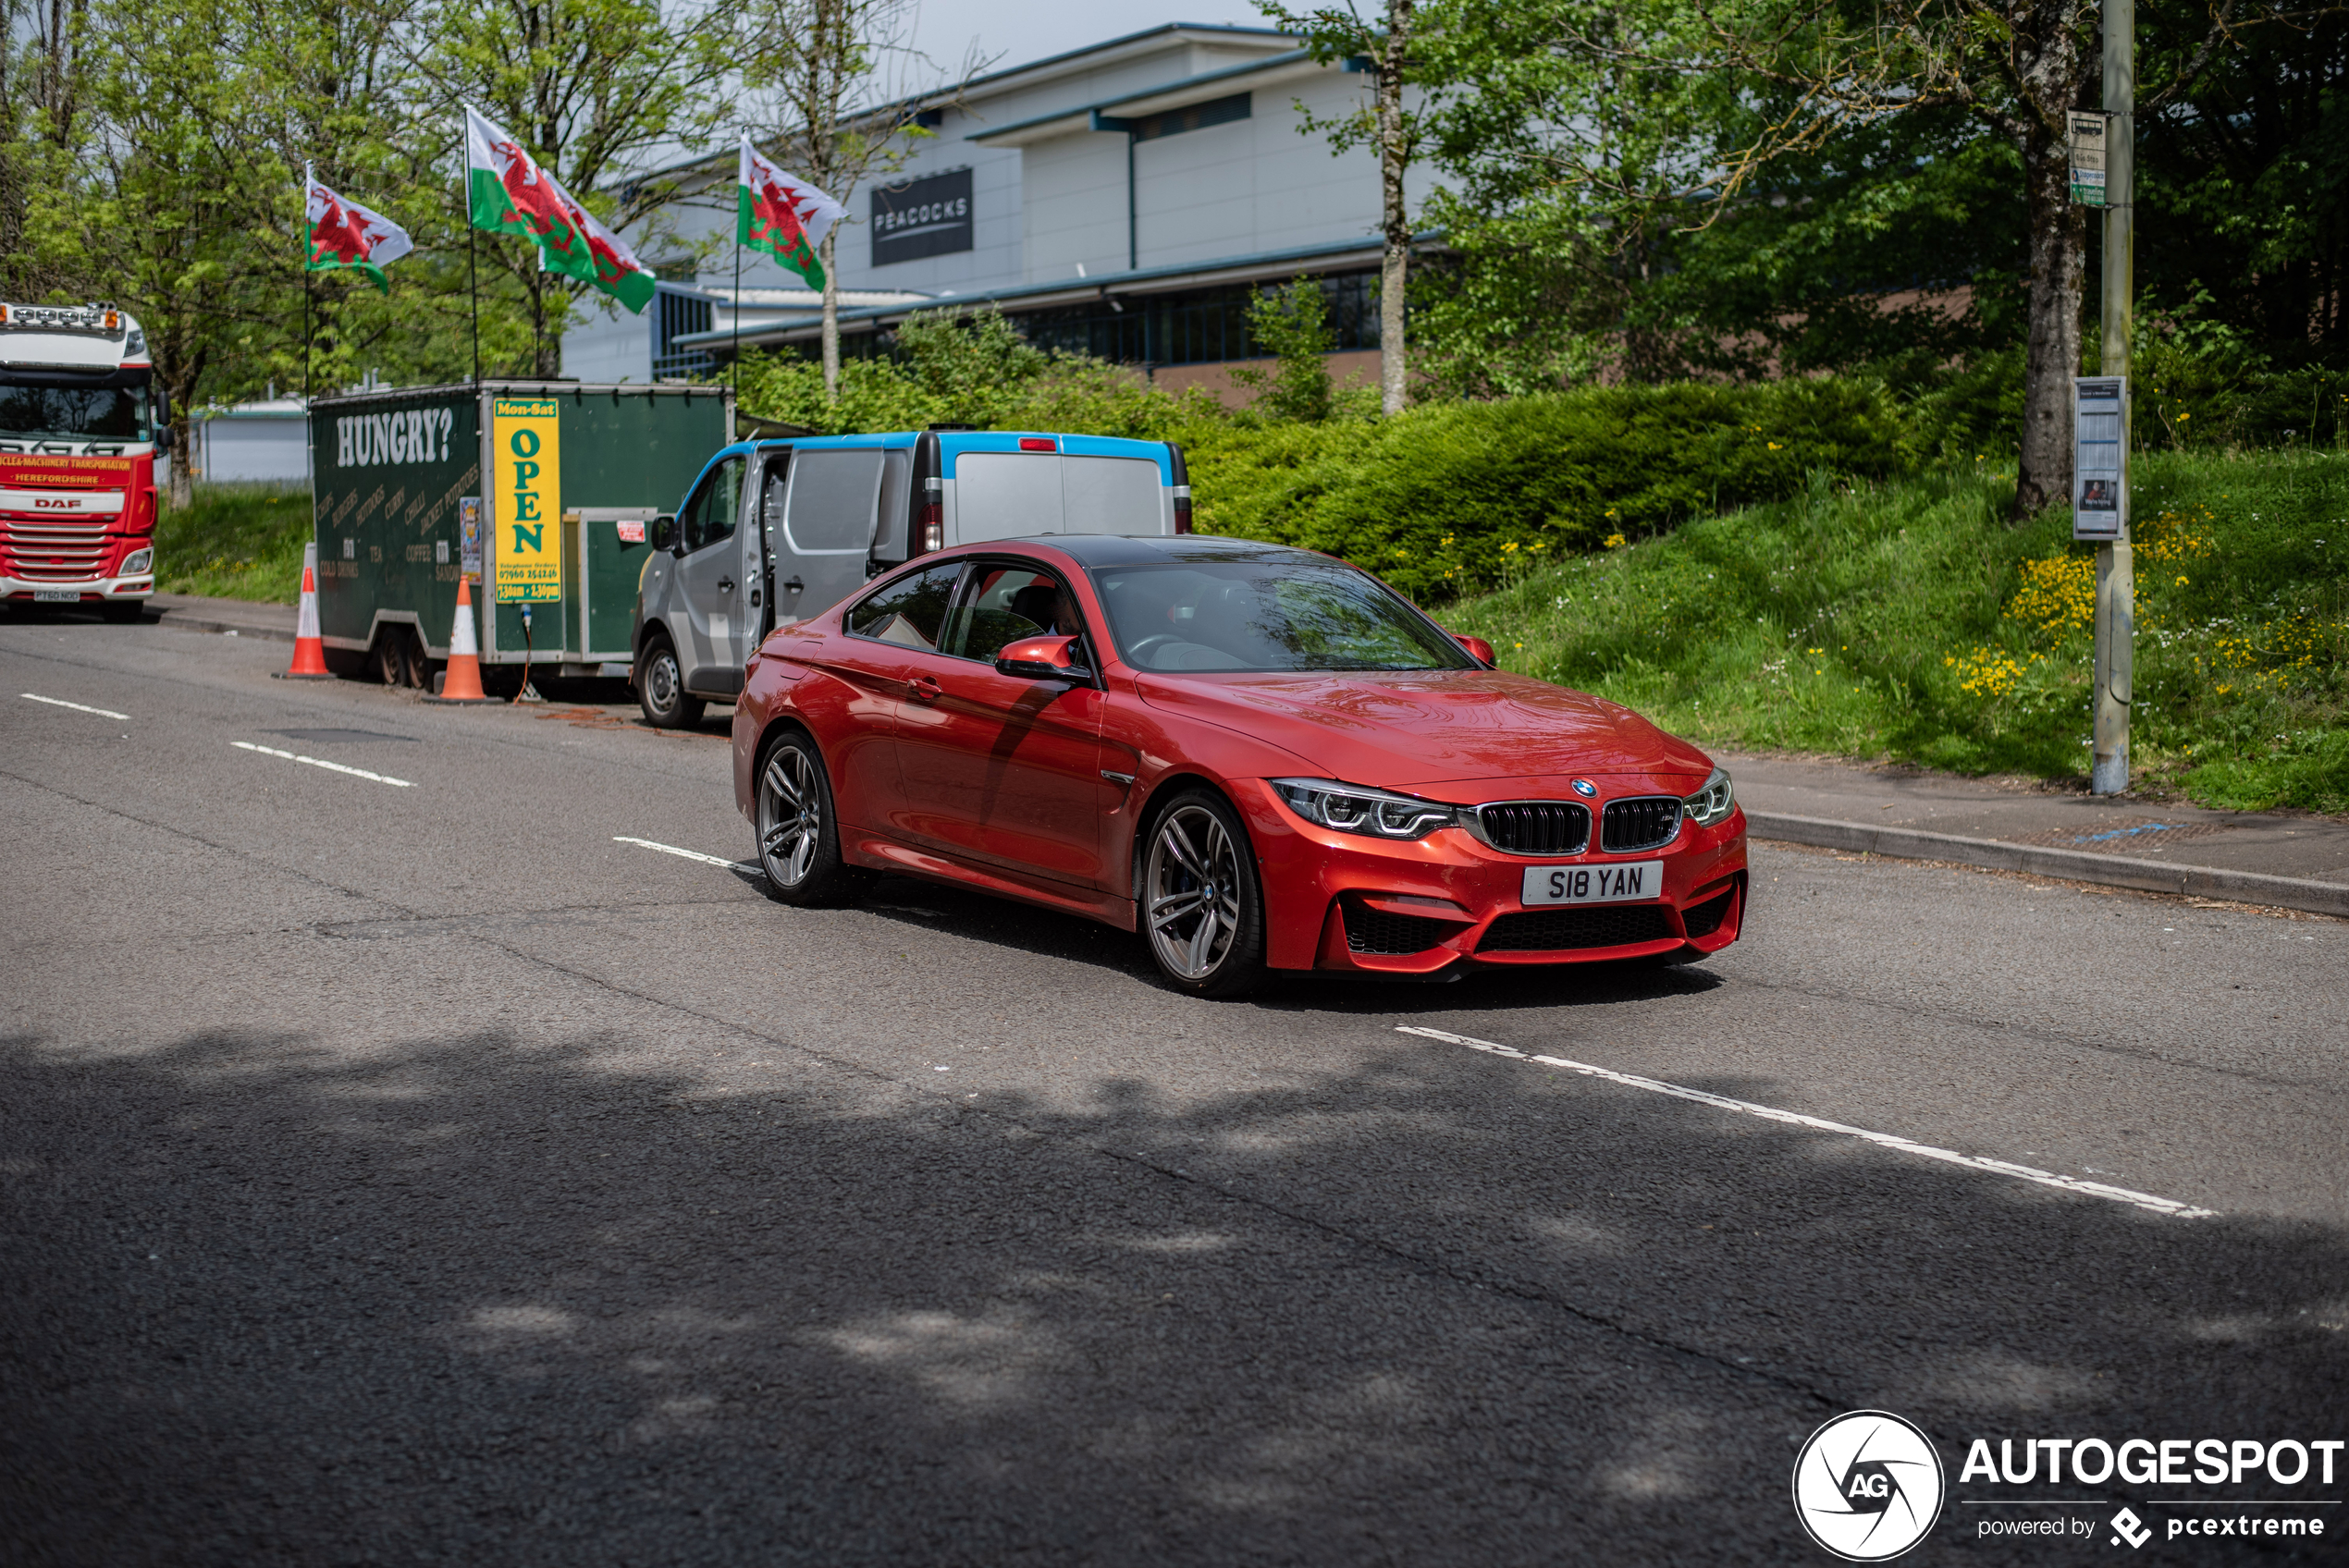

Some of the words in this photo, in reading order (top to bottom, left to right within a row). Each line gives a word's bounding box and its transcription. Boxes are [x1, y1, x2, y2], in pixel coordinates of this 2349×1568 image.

[874, 197, 967, 232] PEACOCKS
[497, 402, 555, 416] Mon-Sat
[337, 407, 453, 467] HUNGRY?
[71, 459, 130, 472] TRANSPORTATION
[15, 473, 99, 484] HEREFORDSHIRE
[420, 497, 444, 536] JACKET
[444, 462, 478, 511] POTATOES
[510, 429, 545, 553] OPEN
[35, 499, 81, 508] DAF
[385, 485, 405, 520] CURRY
[404, 490, 425, 526] CHILLI
[369, 545, 383, 563] TEA
[406, 545, 431, 563] COFFEE
[320, 560, 337, 577] COLD
[338, 560, 359, 578] DRINKS
[499, 570, 524, 581] 07960
[1549, 871, 1590, 899] S18
[1598, 867, 1643, 897] YAN
